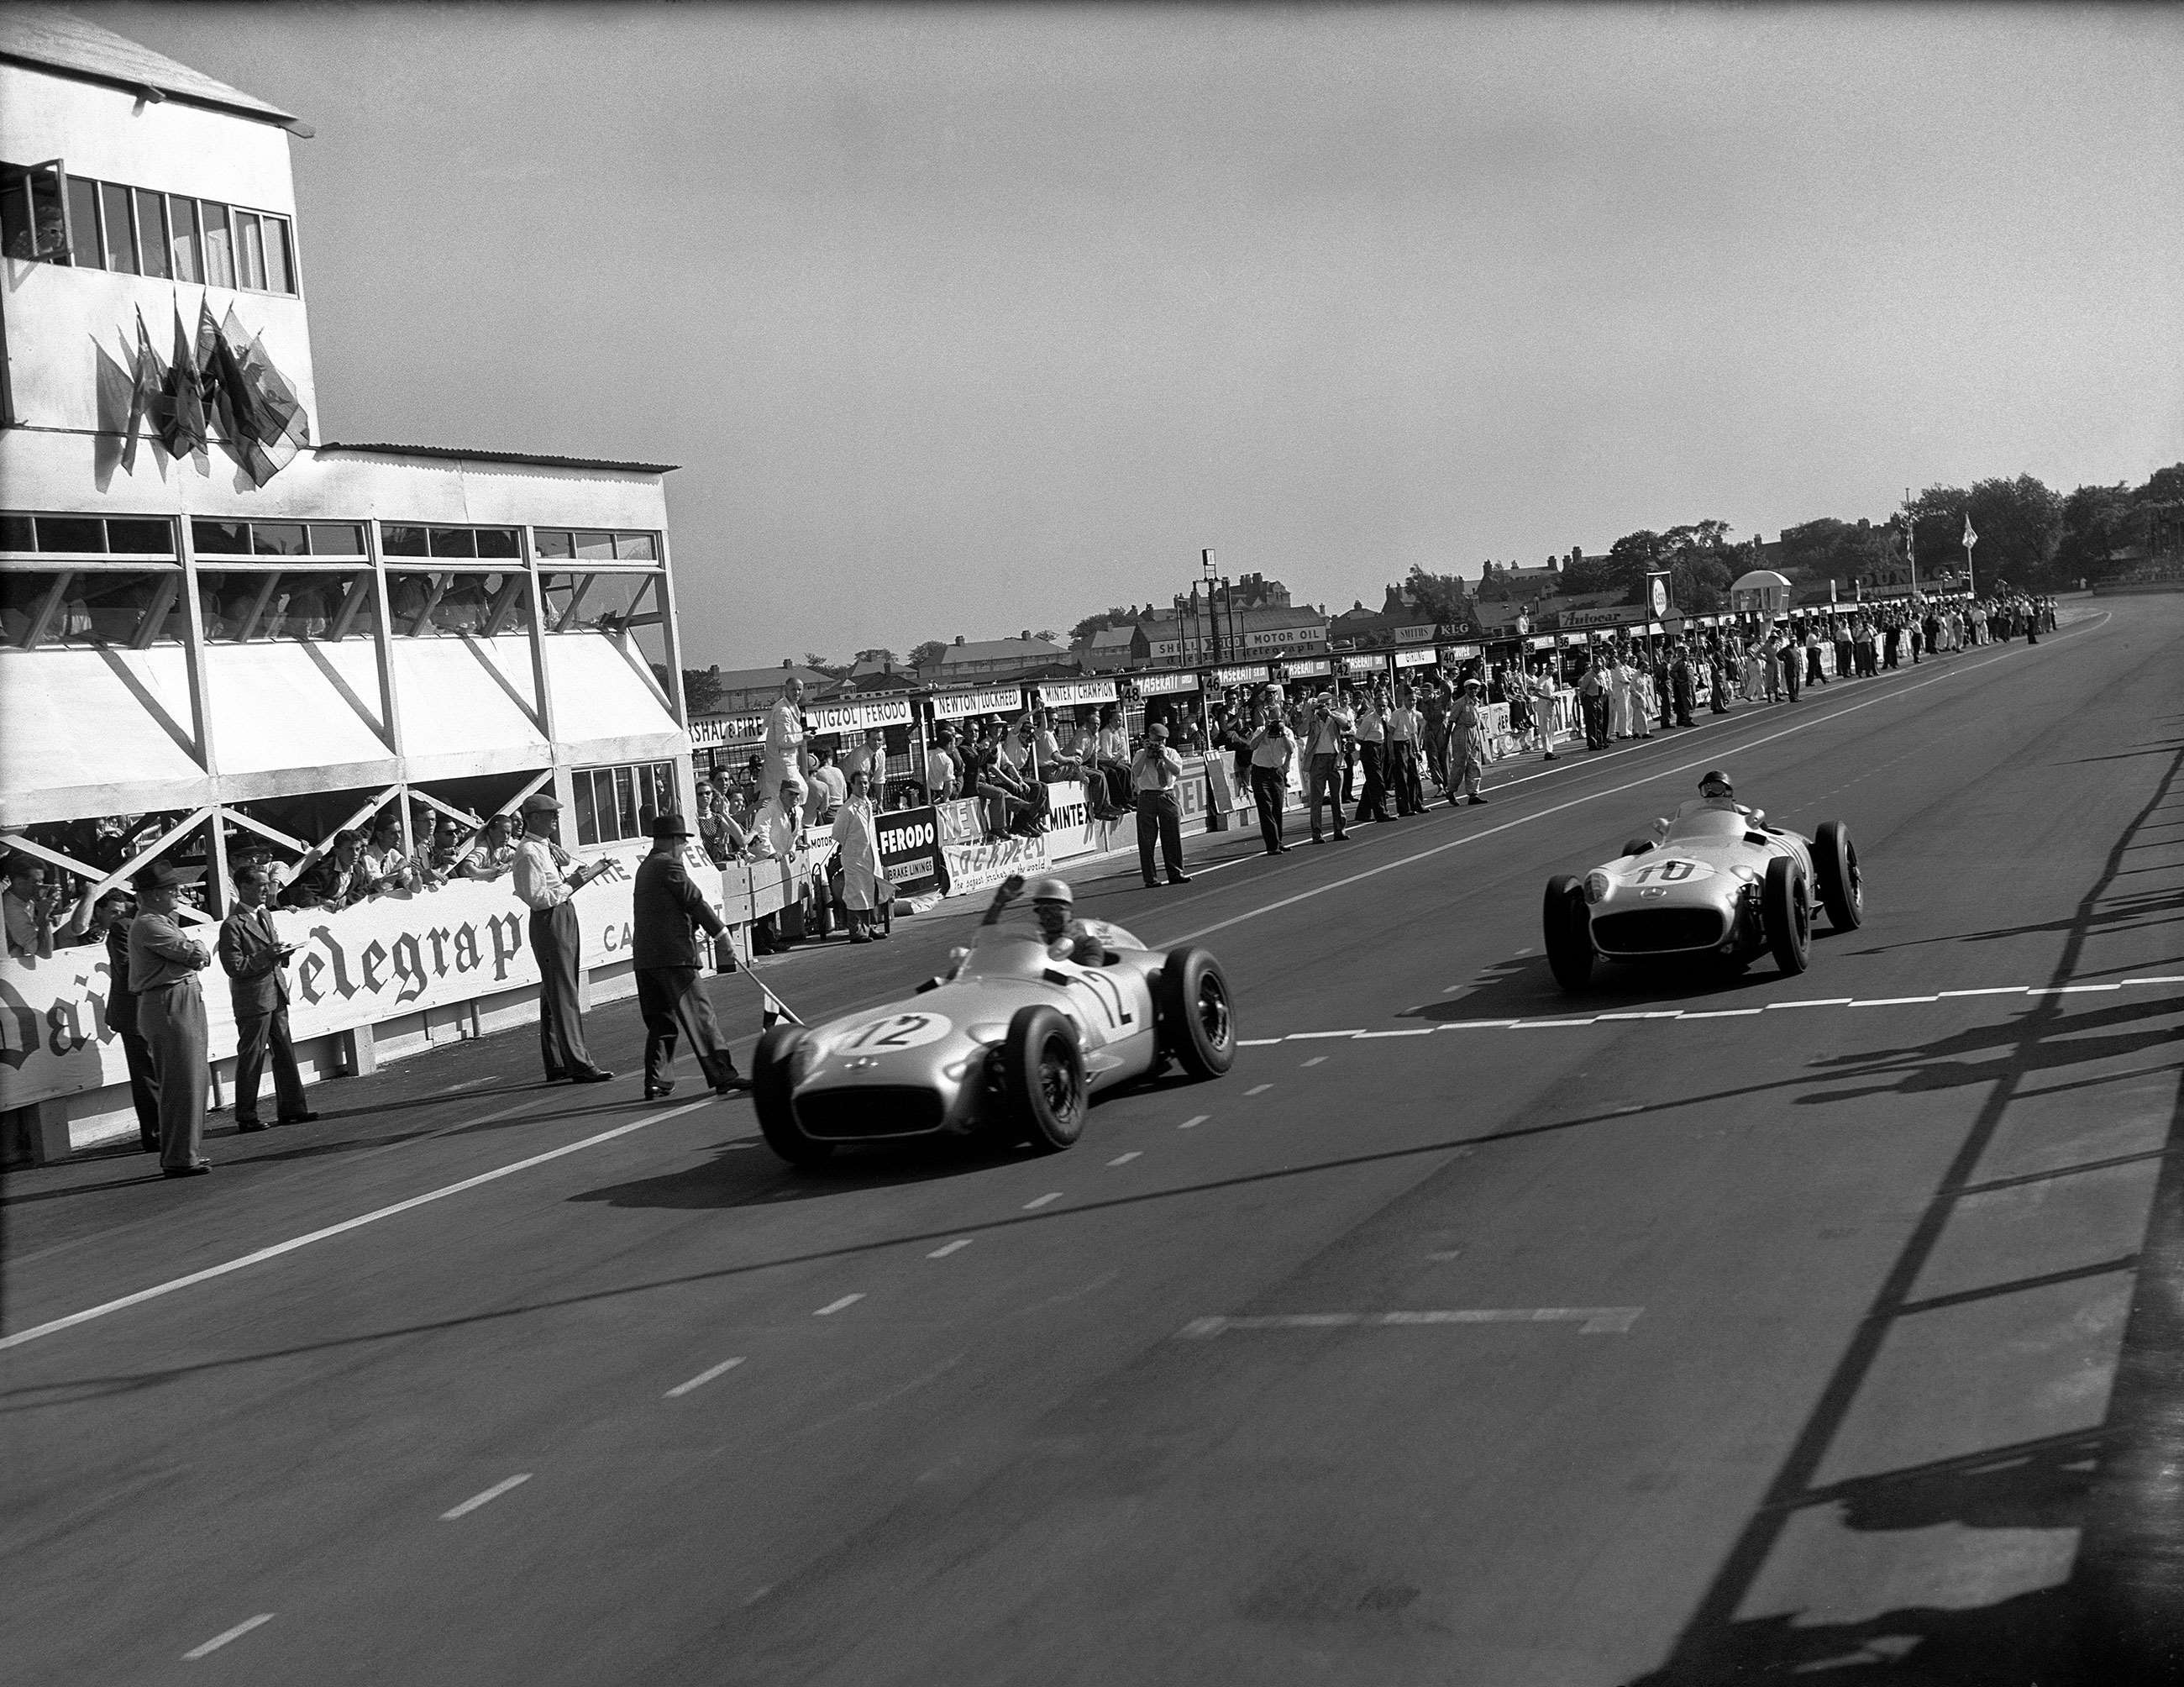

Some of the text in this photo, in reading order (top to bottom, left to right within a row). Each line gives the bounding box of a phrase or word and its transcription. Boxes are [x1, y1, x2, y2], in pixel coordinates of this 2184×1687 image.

[1562, 612, 1621, 626] Autocar
[1254, 632, 1294, 644] MOTOR
[1299, 629, 1320, 640] OIL
[1400, 627, 1430, 639] SMITHS
[1559, 637, 1569, 648] 36
[1444, 653, 1455, 664] 40
[1525, 643, 1535, 654] 38
[1276, 671, 1289, 682] 44
[1336, 665, 1348, 676] 42
[1045, 681, 1115, 702] MINTEX CHAMPION
[1125, 687, 1140, 702] 48
[1206, 677, 1219, 691] 46
[938, 689, 1018, 714] NEWTON LOCKHEED
[814, 702, 906, 729] VIGZOL FERODO
[737, 716, 763, 738] FIRE
[1050, 801, 1093, 832] MINTEX
[879, 822, 934, 854] FERODO
[948, 835, 1045, 877] LOCKHEED
[889, 860, 933, 880] BRAKE LININGS
[1635, 860, 1695, 885] 10
[603, 922, 634, 952] CA
[299, 912, 523, 1006] elegrap
[1068, 970, 1133, 1028] 12
[852, 1015, 930, 1049] 12
